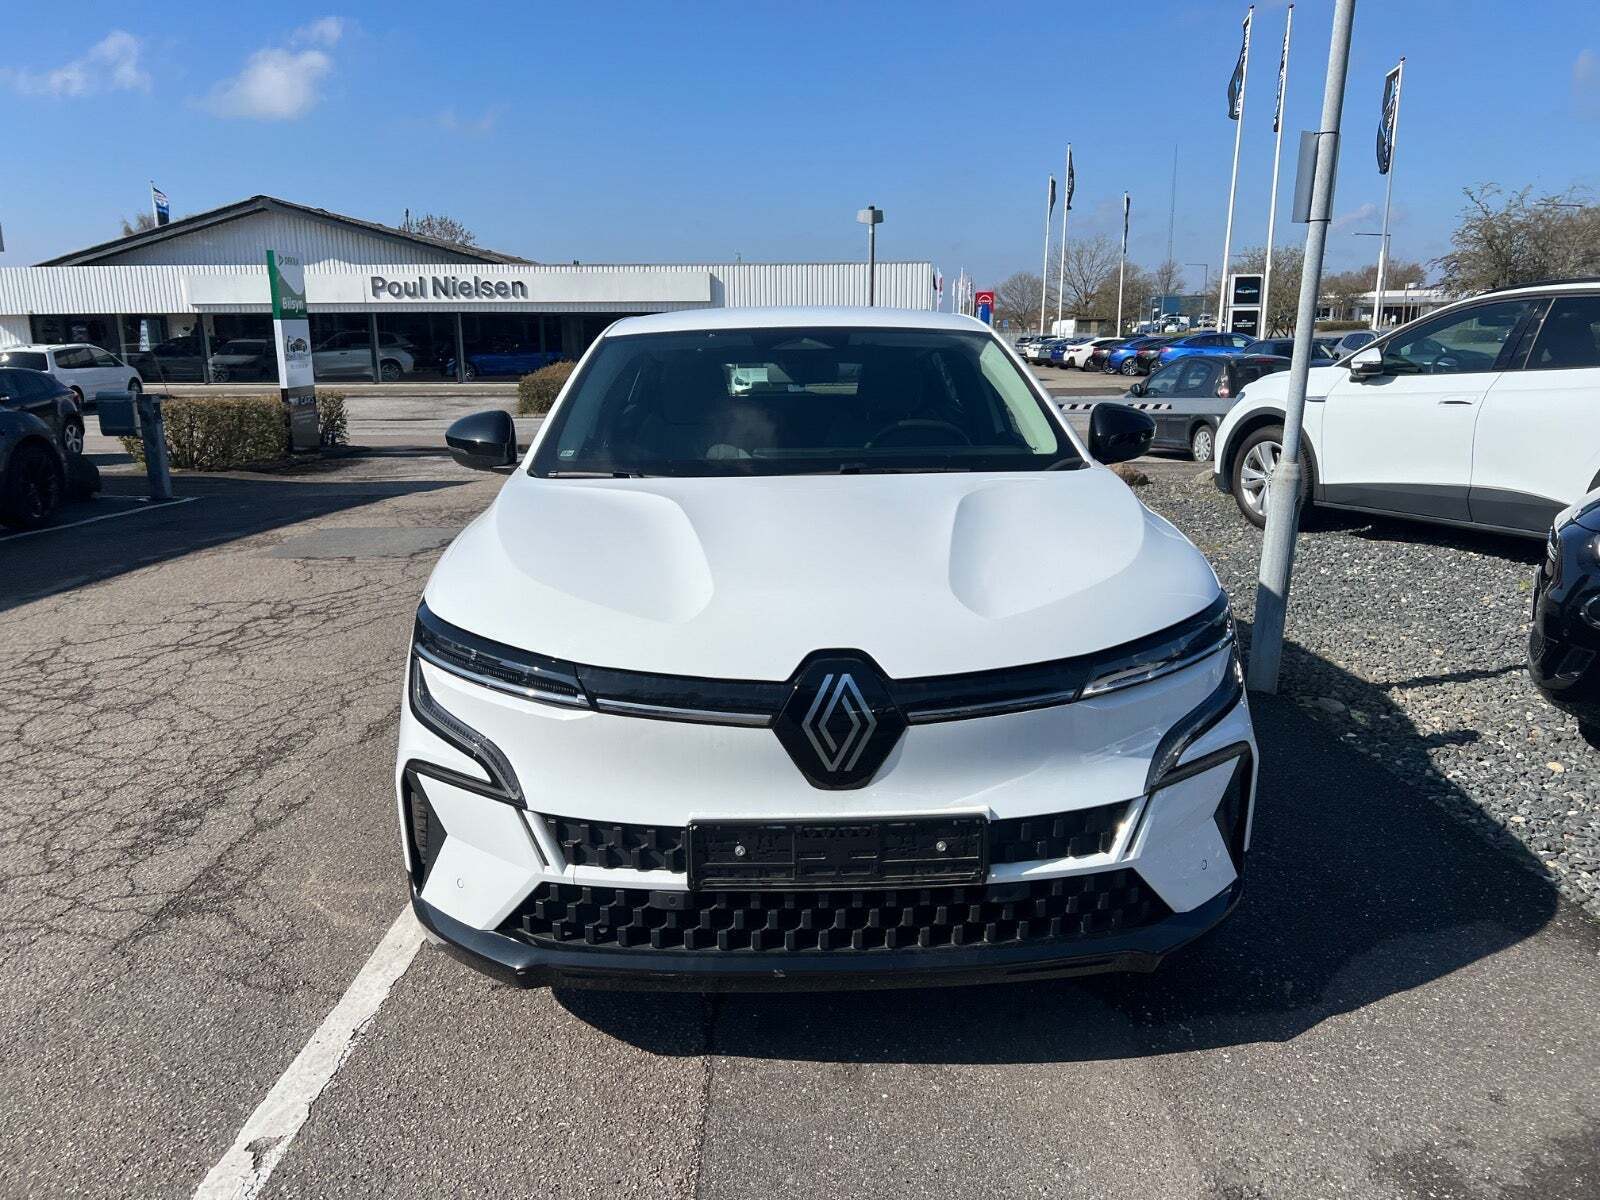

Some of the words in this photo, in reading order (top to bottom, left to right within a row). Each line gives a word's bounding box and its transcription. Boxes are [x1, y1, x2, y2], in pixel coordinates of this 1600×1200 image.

[371, 276, 427, 299] Poul
[431, 275, 528, 299] Nielsen
[282, 297, 304, 313] Bilsyn
